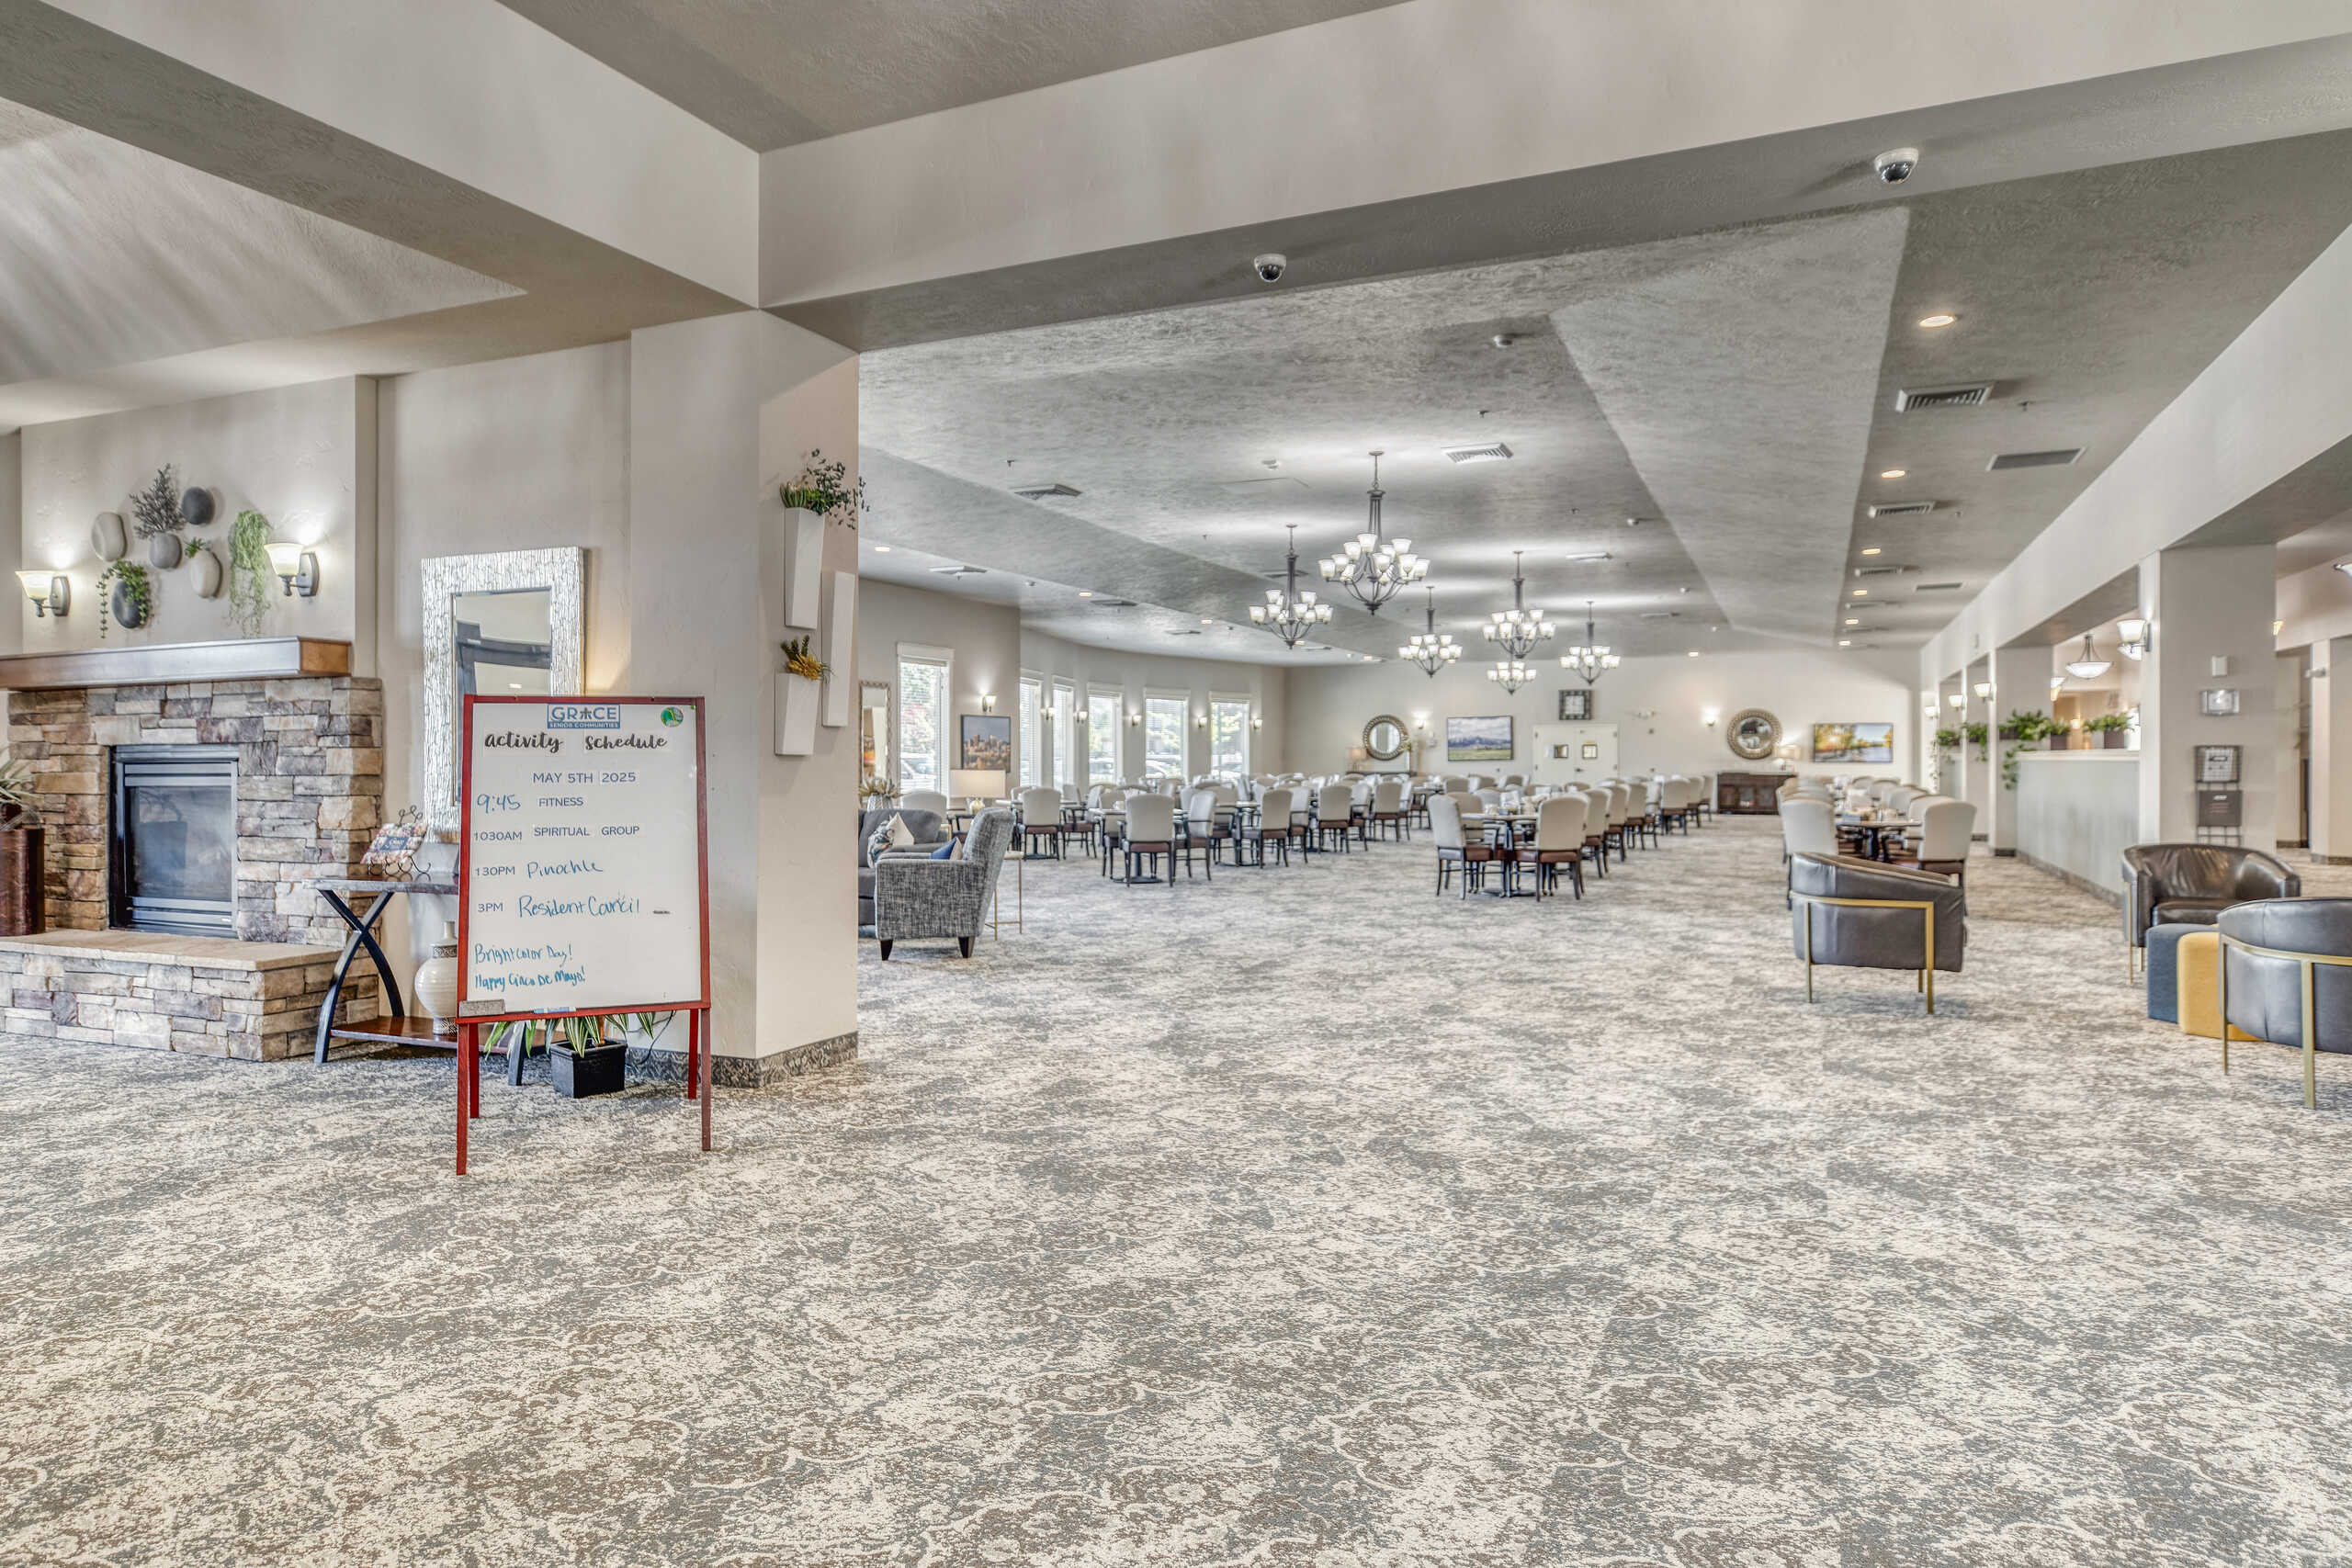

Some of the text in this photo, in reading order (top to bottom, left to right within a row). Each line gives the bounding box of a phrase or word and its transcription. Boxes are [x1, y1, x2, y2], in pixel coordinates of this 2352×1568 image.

[584, 734, 668, 750] Schedule
[533, 772, 637, 784] MAY 5TH 2025
[477, 793, 521, 814] 9:45
[538, 797, 584, 807] FITNESS
[474, 831, 523, 841] 1030AM
[534, 826, 640, 837] SPIRITUAL GROUP
[475, 866, 515, 876] 130PM
[478, 902, 503, 912] 3PM
[518, 895, 586, 918] Resident
[474, 974, 505, 992] Happy
